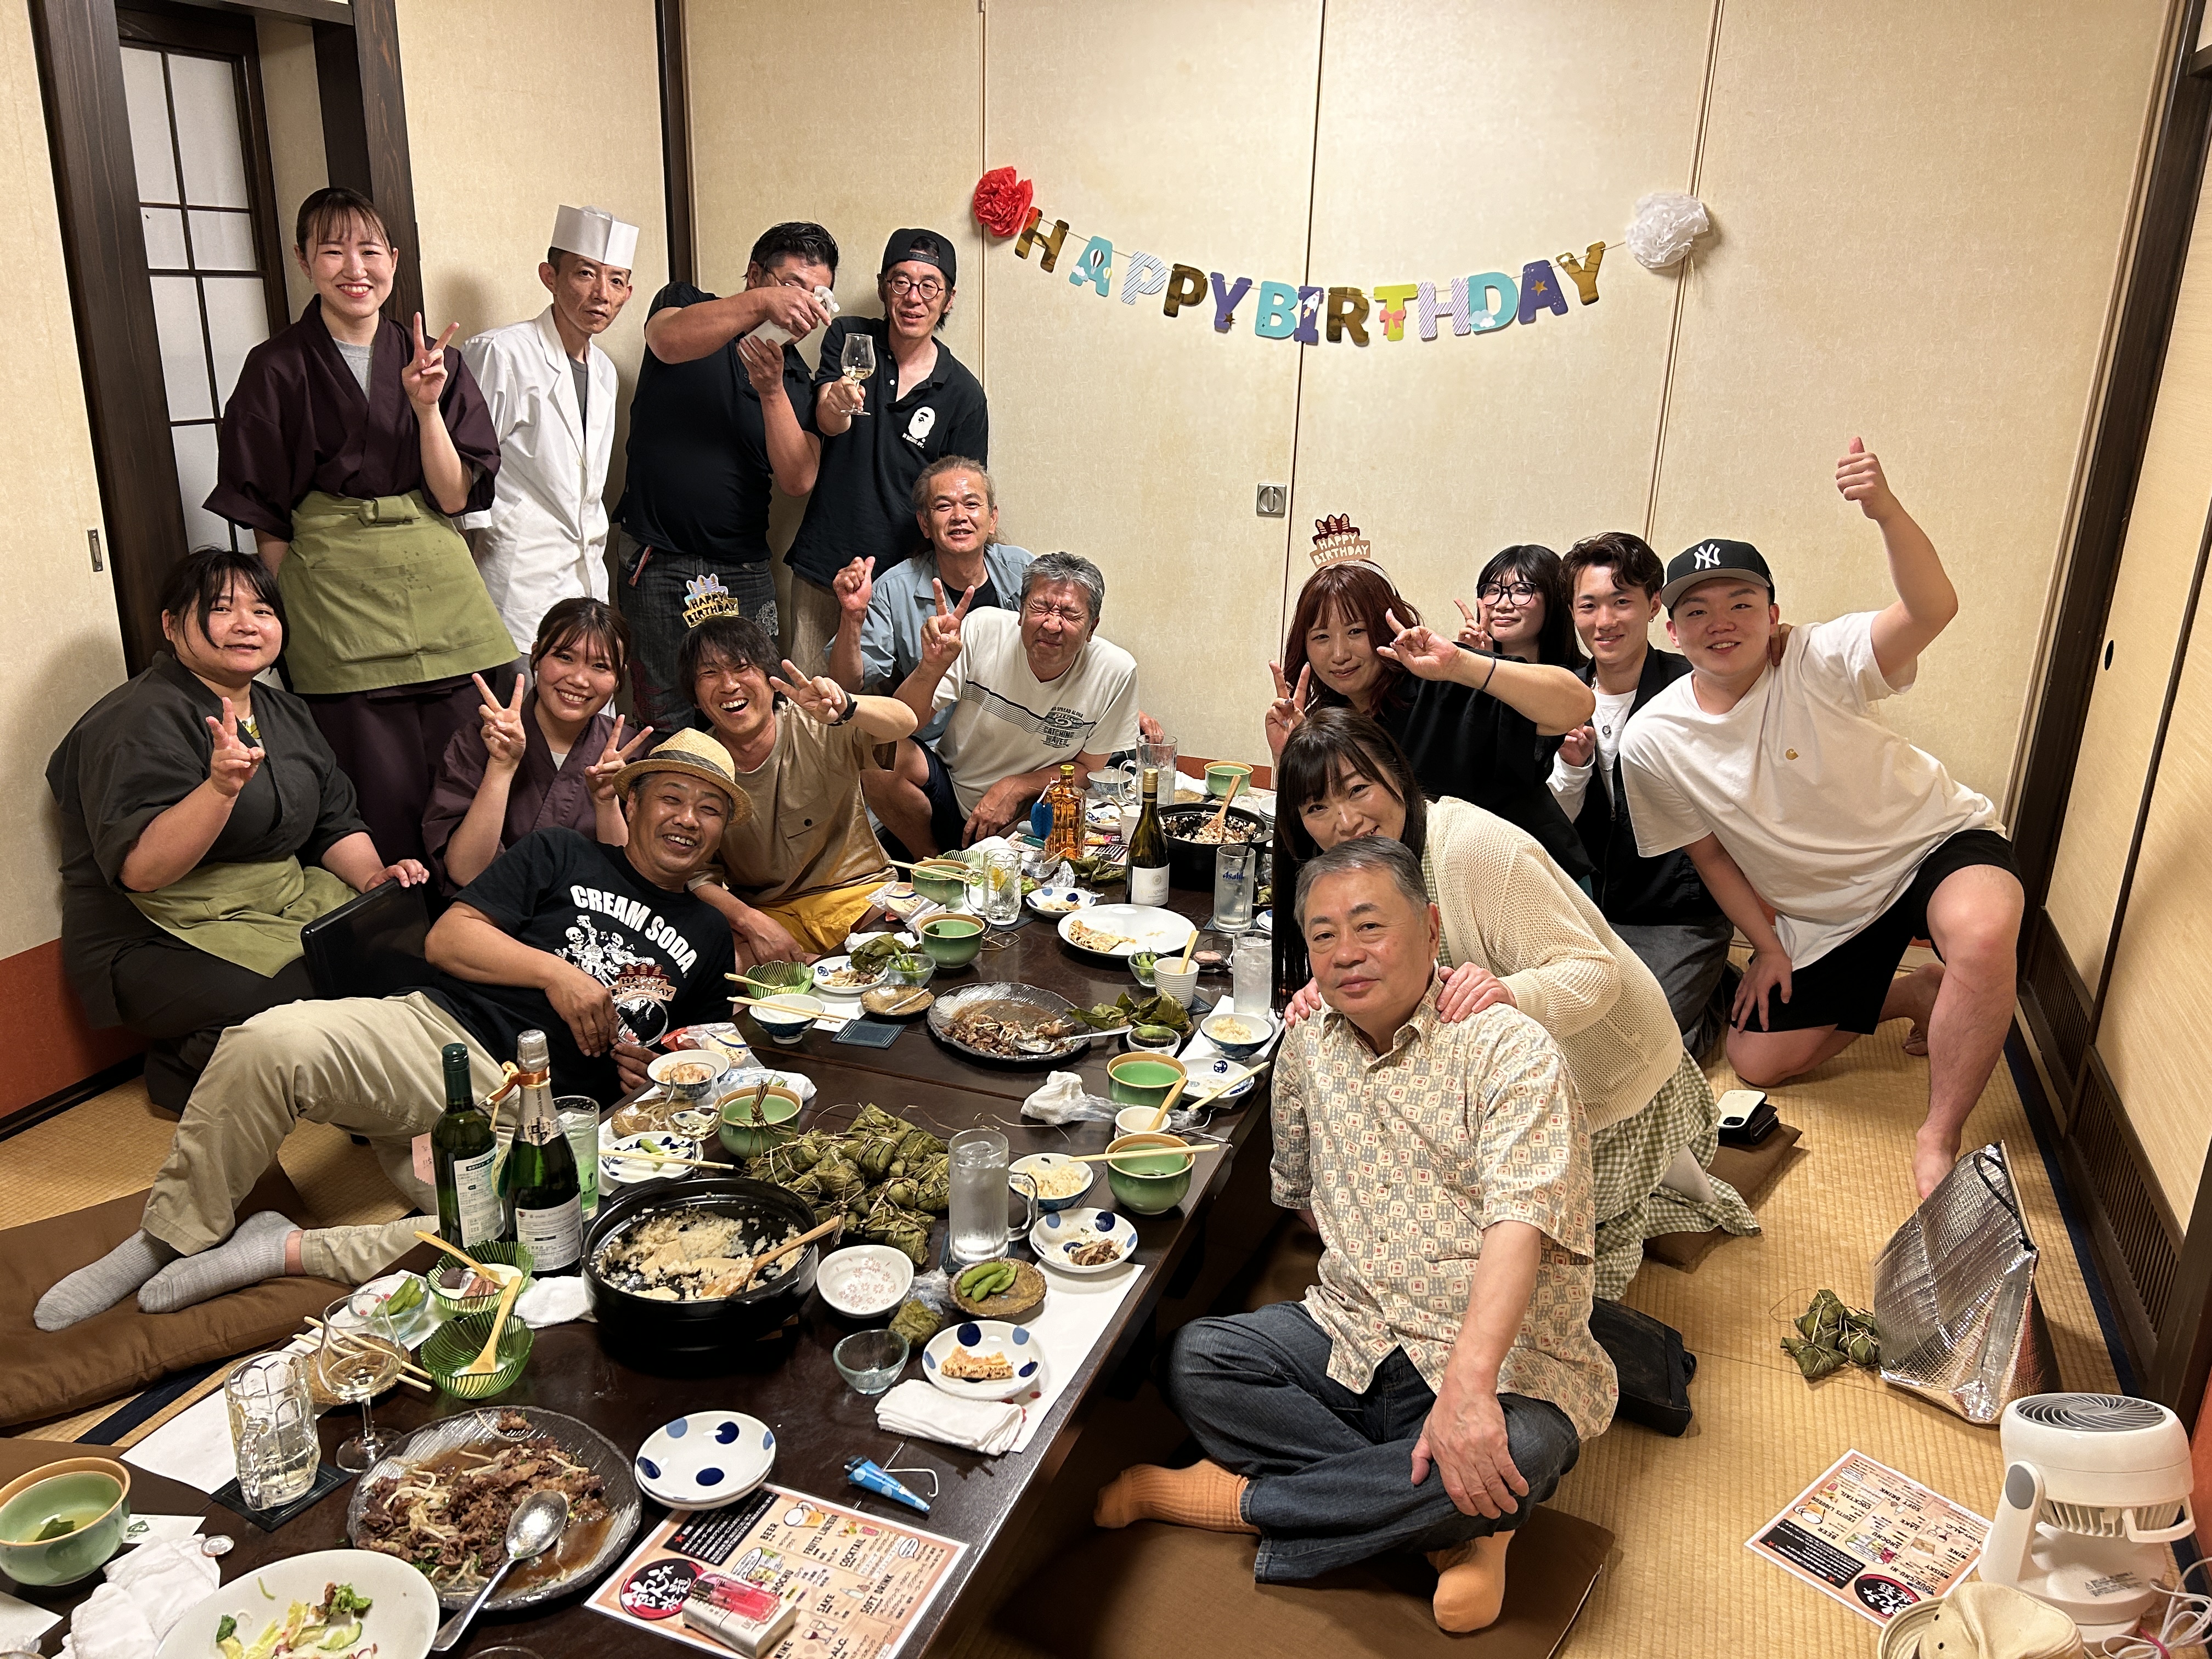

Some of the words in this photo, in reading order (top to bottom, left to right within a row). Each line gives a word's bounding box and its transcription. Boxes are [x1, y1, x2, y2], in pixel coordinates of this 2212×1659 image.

[1014, 207, 1252, 333] HAPPY
[1255, 241, 1606, 347] BIRTHDAY
[1318, 534, 1357, 550] HAPPY
[1313, 545, 1369, 566] BIRTHDAY
[1694, 543, 1721, 570] NY
[691, 592, 725, 610] HAPPY
[686, 603, 737, 623] BIRTHDAY
[569, 885, 652, 932] CREAM
[645, 916, 697, 974] SODA
[1840, 1490, 1871, 1509] COCKTAIL
[1880, 1487, 1901, 1501] DRINK
[1902, 1500, 1921, 1513] SOFT
[1835, 1509, 1856, 1523] FRUITS
[1900, 1519, 1920, 1531] SAKE
[760, 1523, 780, 1542] BEER
[1818, 1527, 1838, 1540] BEER
[1871, 1532, 1900, 1549] SHOCHU
[839, 1538, 867, 1567] COCKTAIL
[1947, 1547, 1968, 1560] WINE
[1925, 1564, 1950, 1580] WHISKY
[860, 1595, 878, 1614] SOFT
[874, 1573, 895, 1595] DRINK
[816, 1593, 836, 1613] SAKE
